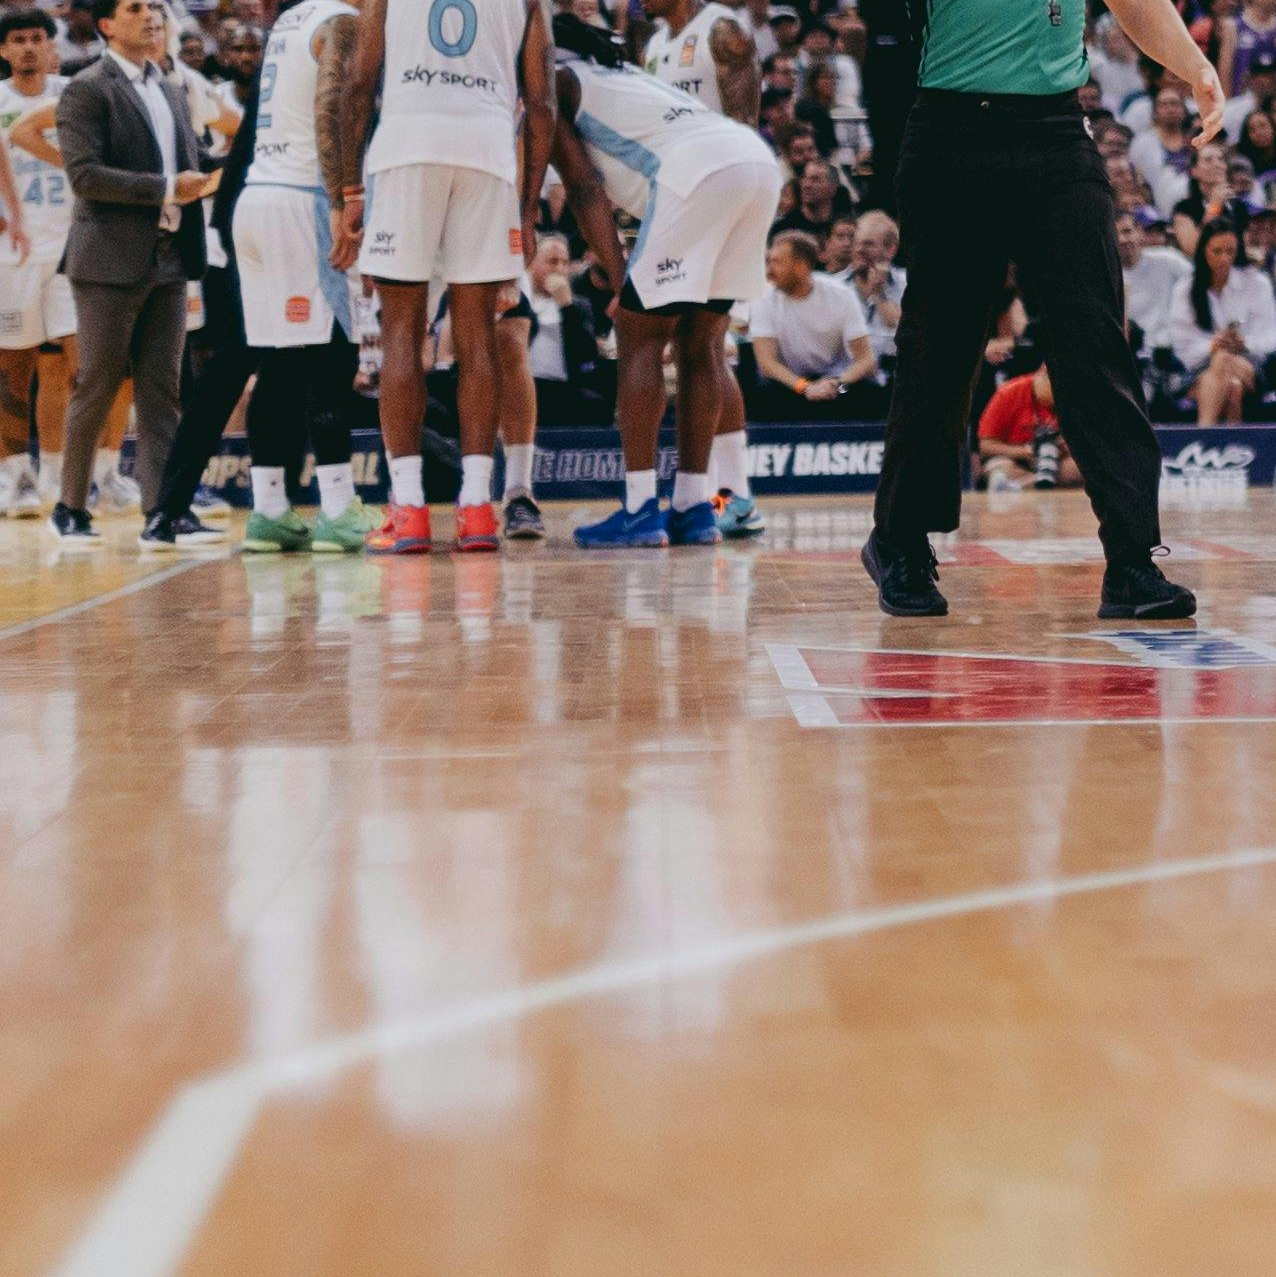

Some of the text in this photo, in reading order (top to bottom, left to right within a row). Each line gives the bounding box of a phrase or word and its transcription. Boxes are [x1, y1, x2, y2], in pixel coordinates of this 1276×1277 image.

[440, 71, 498, 92] SPORT
[23, 176, 64, 205] 42
[376, 229, 395, 243] sky
[657, 256, 683, 271] sky
